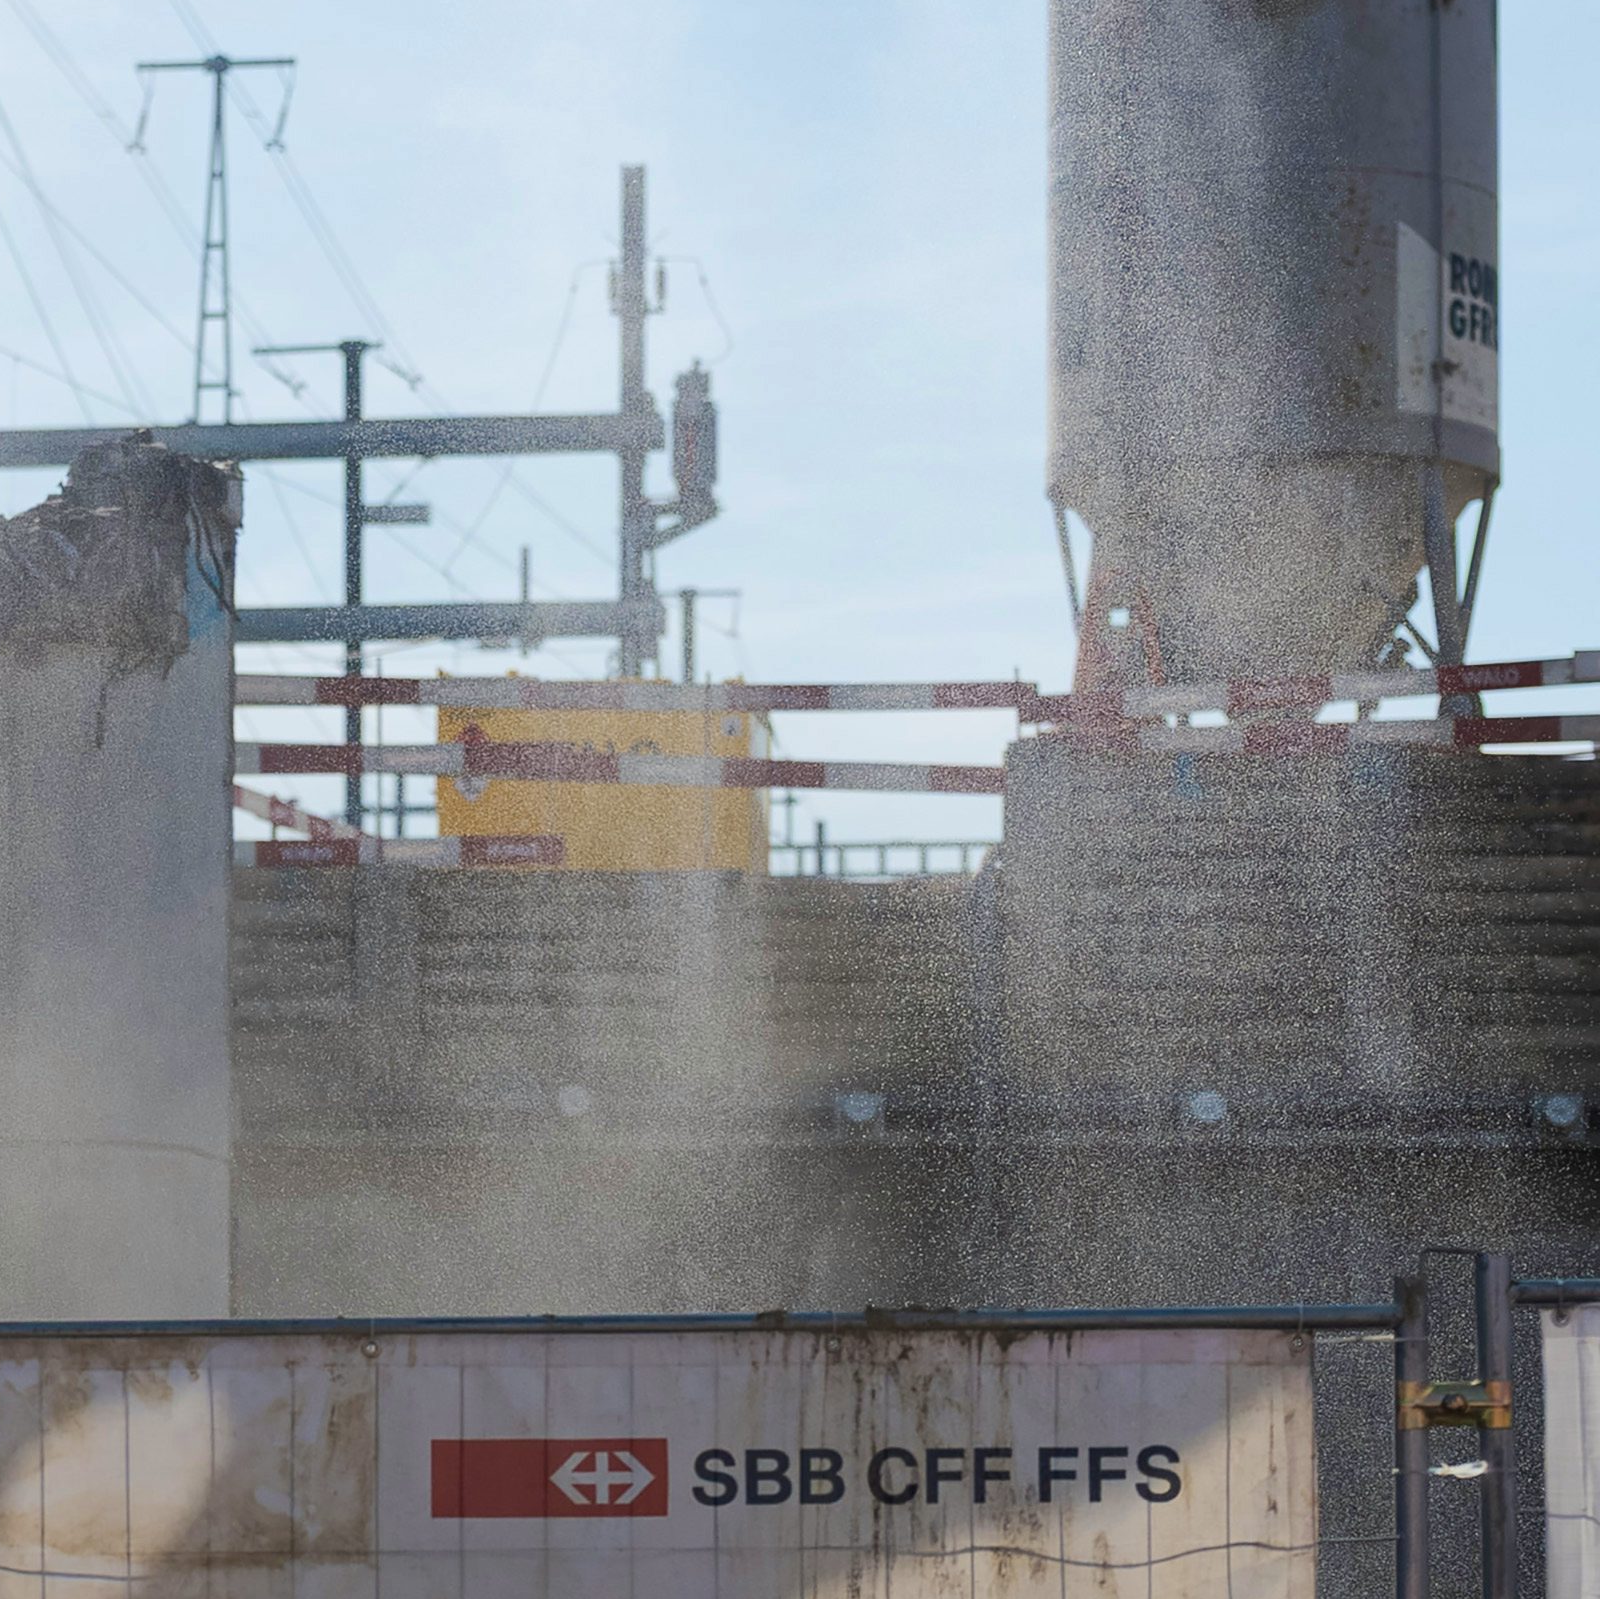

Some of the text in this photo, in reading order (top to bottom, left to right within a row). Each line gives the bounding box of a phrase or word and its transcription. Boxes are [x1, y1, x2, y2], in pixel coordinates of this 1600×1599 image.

[692, 1445, 1181, 1506] SBB CFF FFS
